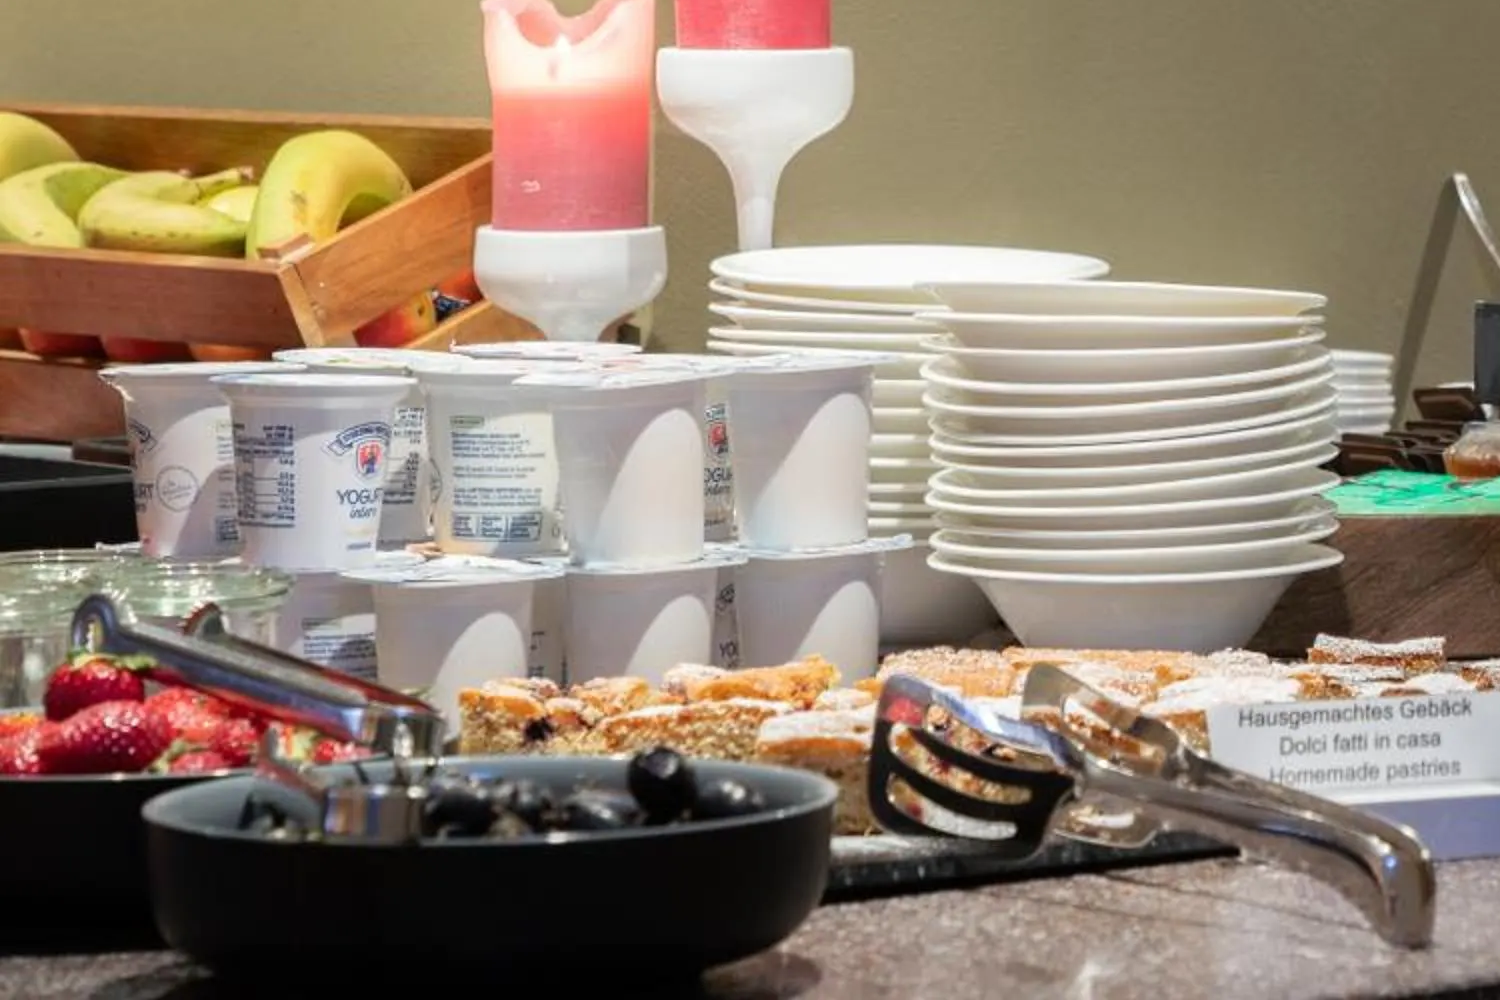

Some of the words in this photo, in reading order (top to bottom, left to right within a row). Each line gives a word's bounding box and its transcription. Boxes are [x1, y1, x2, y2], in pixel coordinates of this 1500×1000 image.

[1238, 703, 1394, 729] Hausgemachtes
[1400, 698, 1472, 718] Gebäck
[1279, 735, 1327, 756] Dolci
[1333, 732, 1369, 753] fatti
[1374, 731, 1391, 750] in
[1396, 731, 1442, 749] casa
[1269, 761, 1380, 786] Homemade
[1385, 759, 1462, 784] pastries
